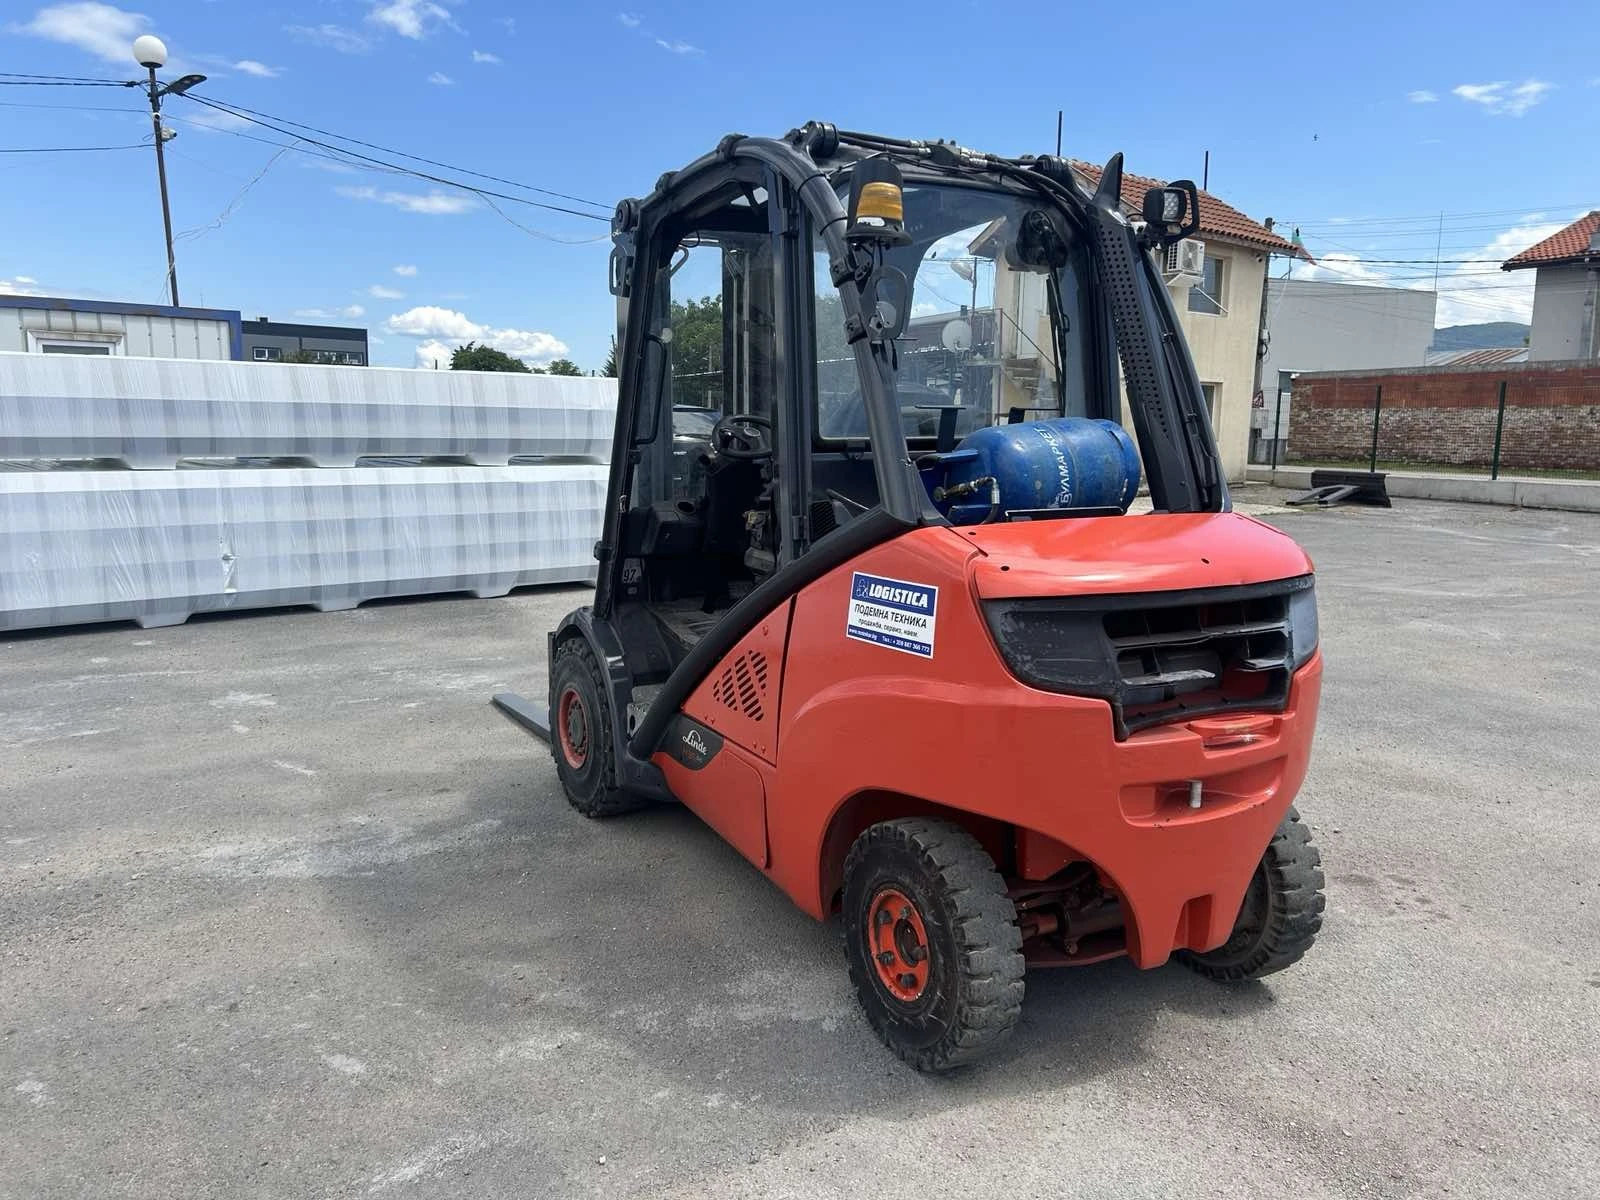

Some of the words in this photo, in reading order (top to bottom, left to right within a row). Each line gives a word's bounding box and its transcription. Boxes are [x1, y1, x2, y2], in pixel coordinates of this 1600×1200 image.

[869, 583, 928, 608] LOGISTICA
[854, 603, 889, 621] ПОДЕМНА
[890, 611, 927, 629] ТЕХНИКА
[682, 729, 708, 756] Linde
